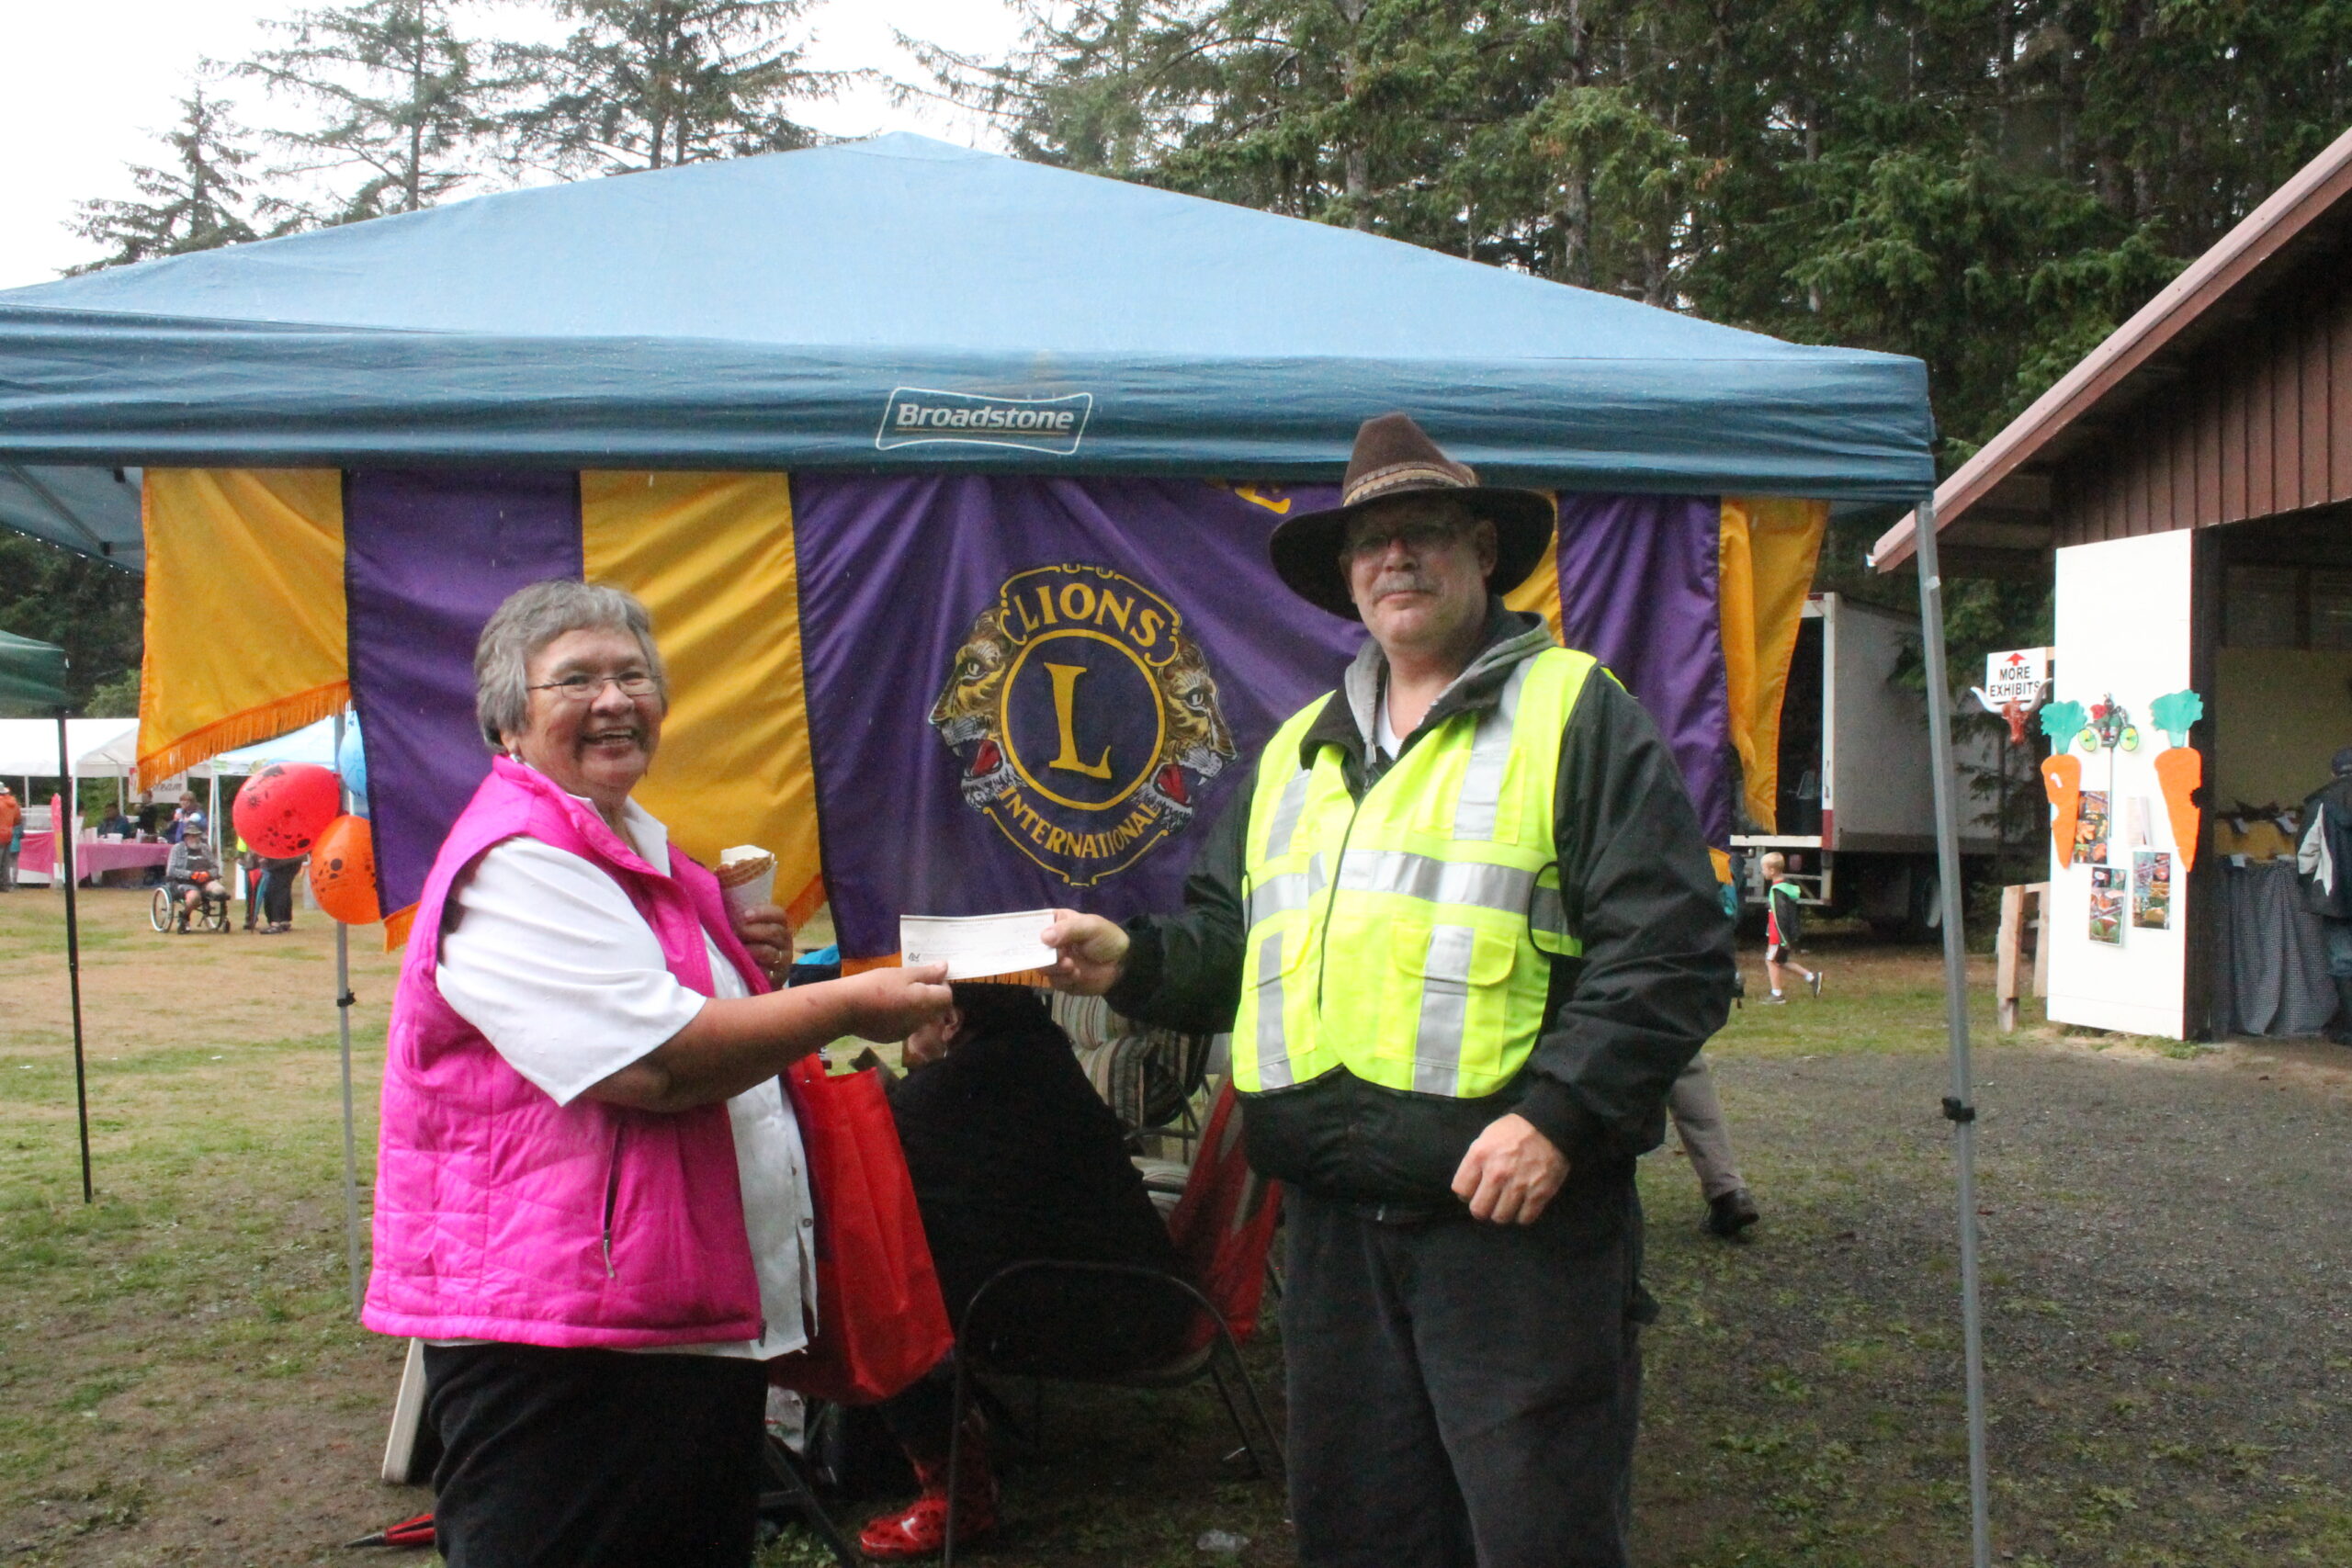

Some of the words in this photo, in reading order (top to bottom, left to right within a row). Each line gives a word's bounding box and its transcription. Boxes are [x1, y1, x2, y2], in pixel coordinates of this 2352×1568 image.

[896, 402, 1075, 430] Broadstone
[1013, 582, 1165, 647] LIONS
[1999, 666, 2030, 681] MORE
[1044, 662, 1113, 780] L
[998, 785, 1161, 860] INTERNATIONAL
